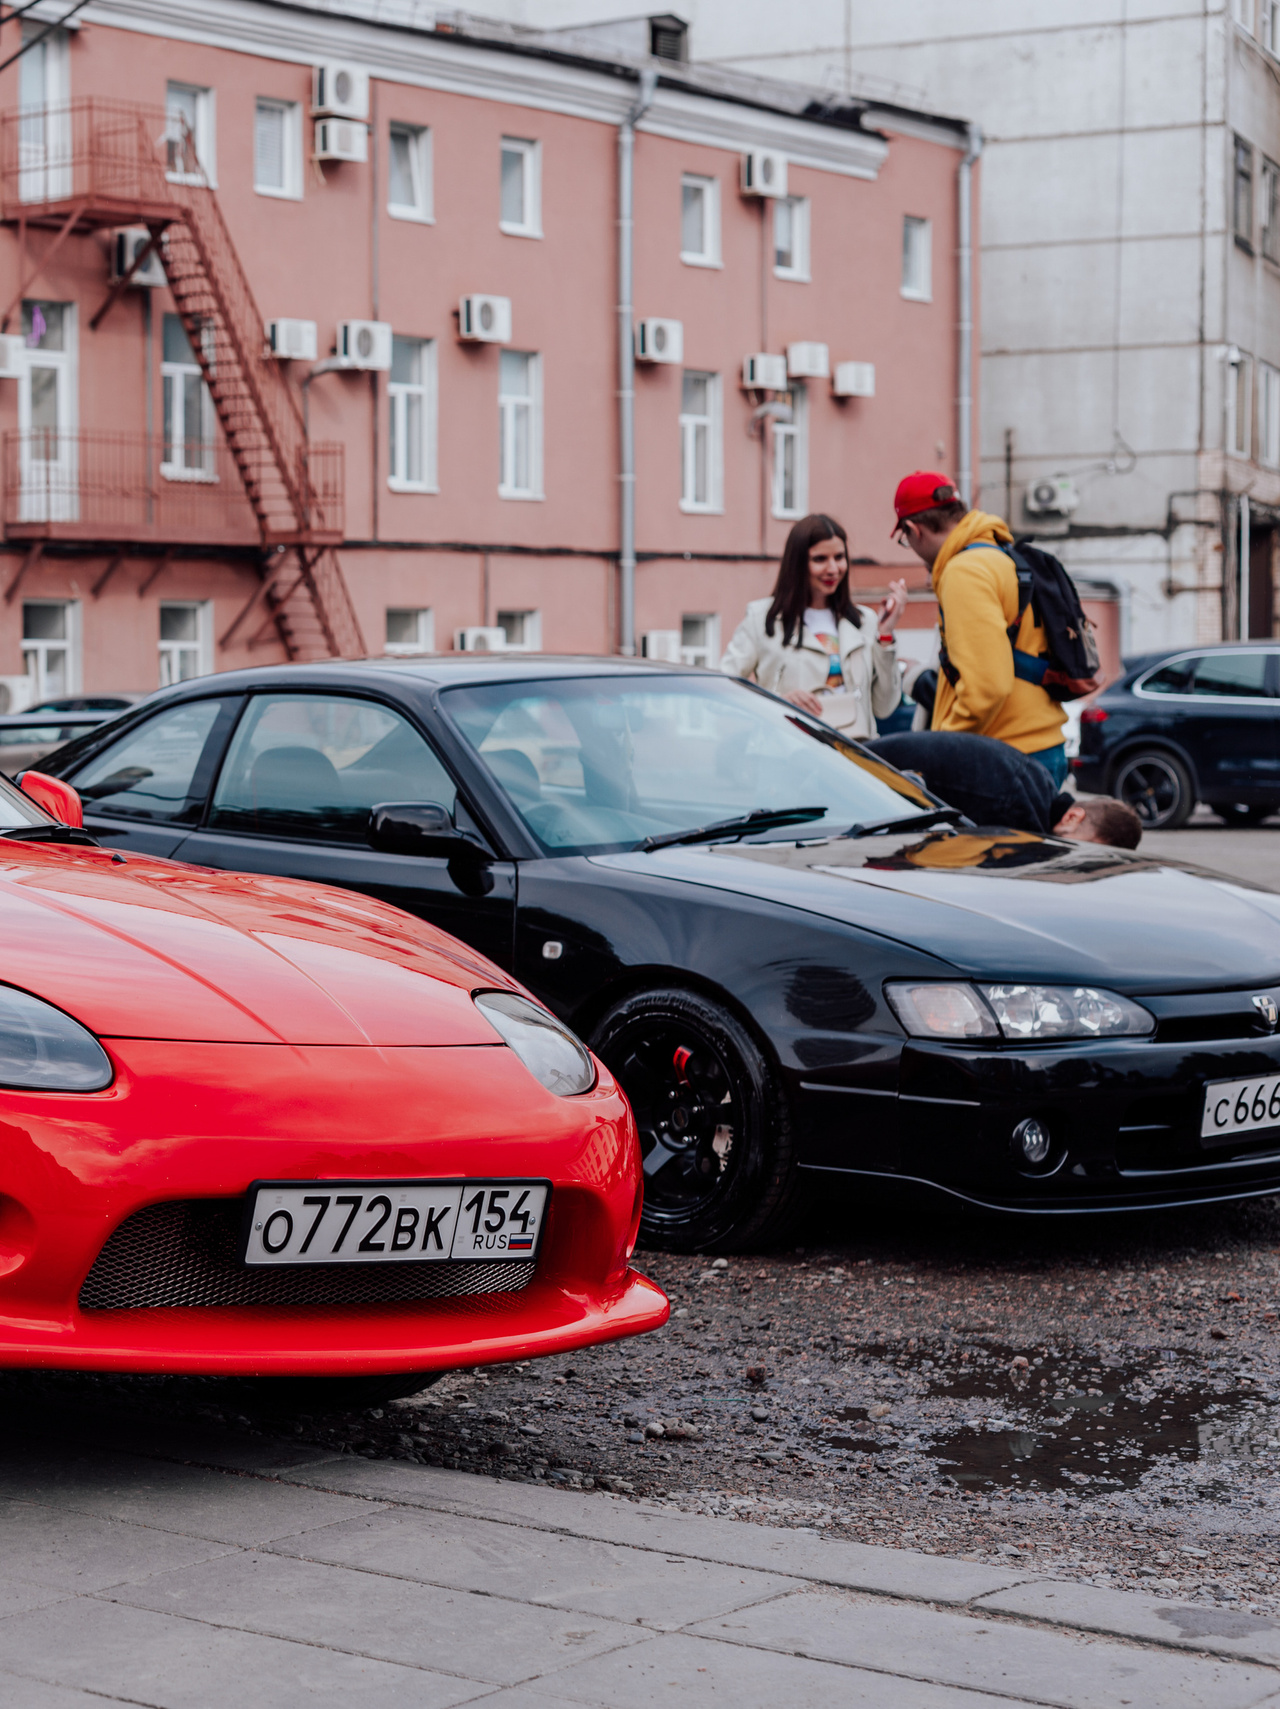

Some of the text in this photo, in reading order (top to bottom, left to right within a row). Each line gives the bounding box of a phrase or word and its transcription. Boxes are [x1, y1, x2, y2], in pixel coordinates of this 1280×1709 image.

[262, 1189, 531, 1254] О772ВК 154
[473, 1233, 508, 1250] RUS
